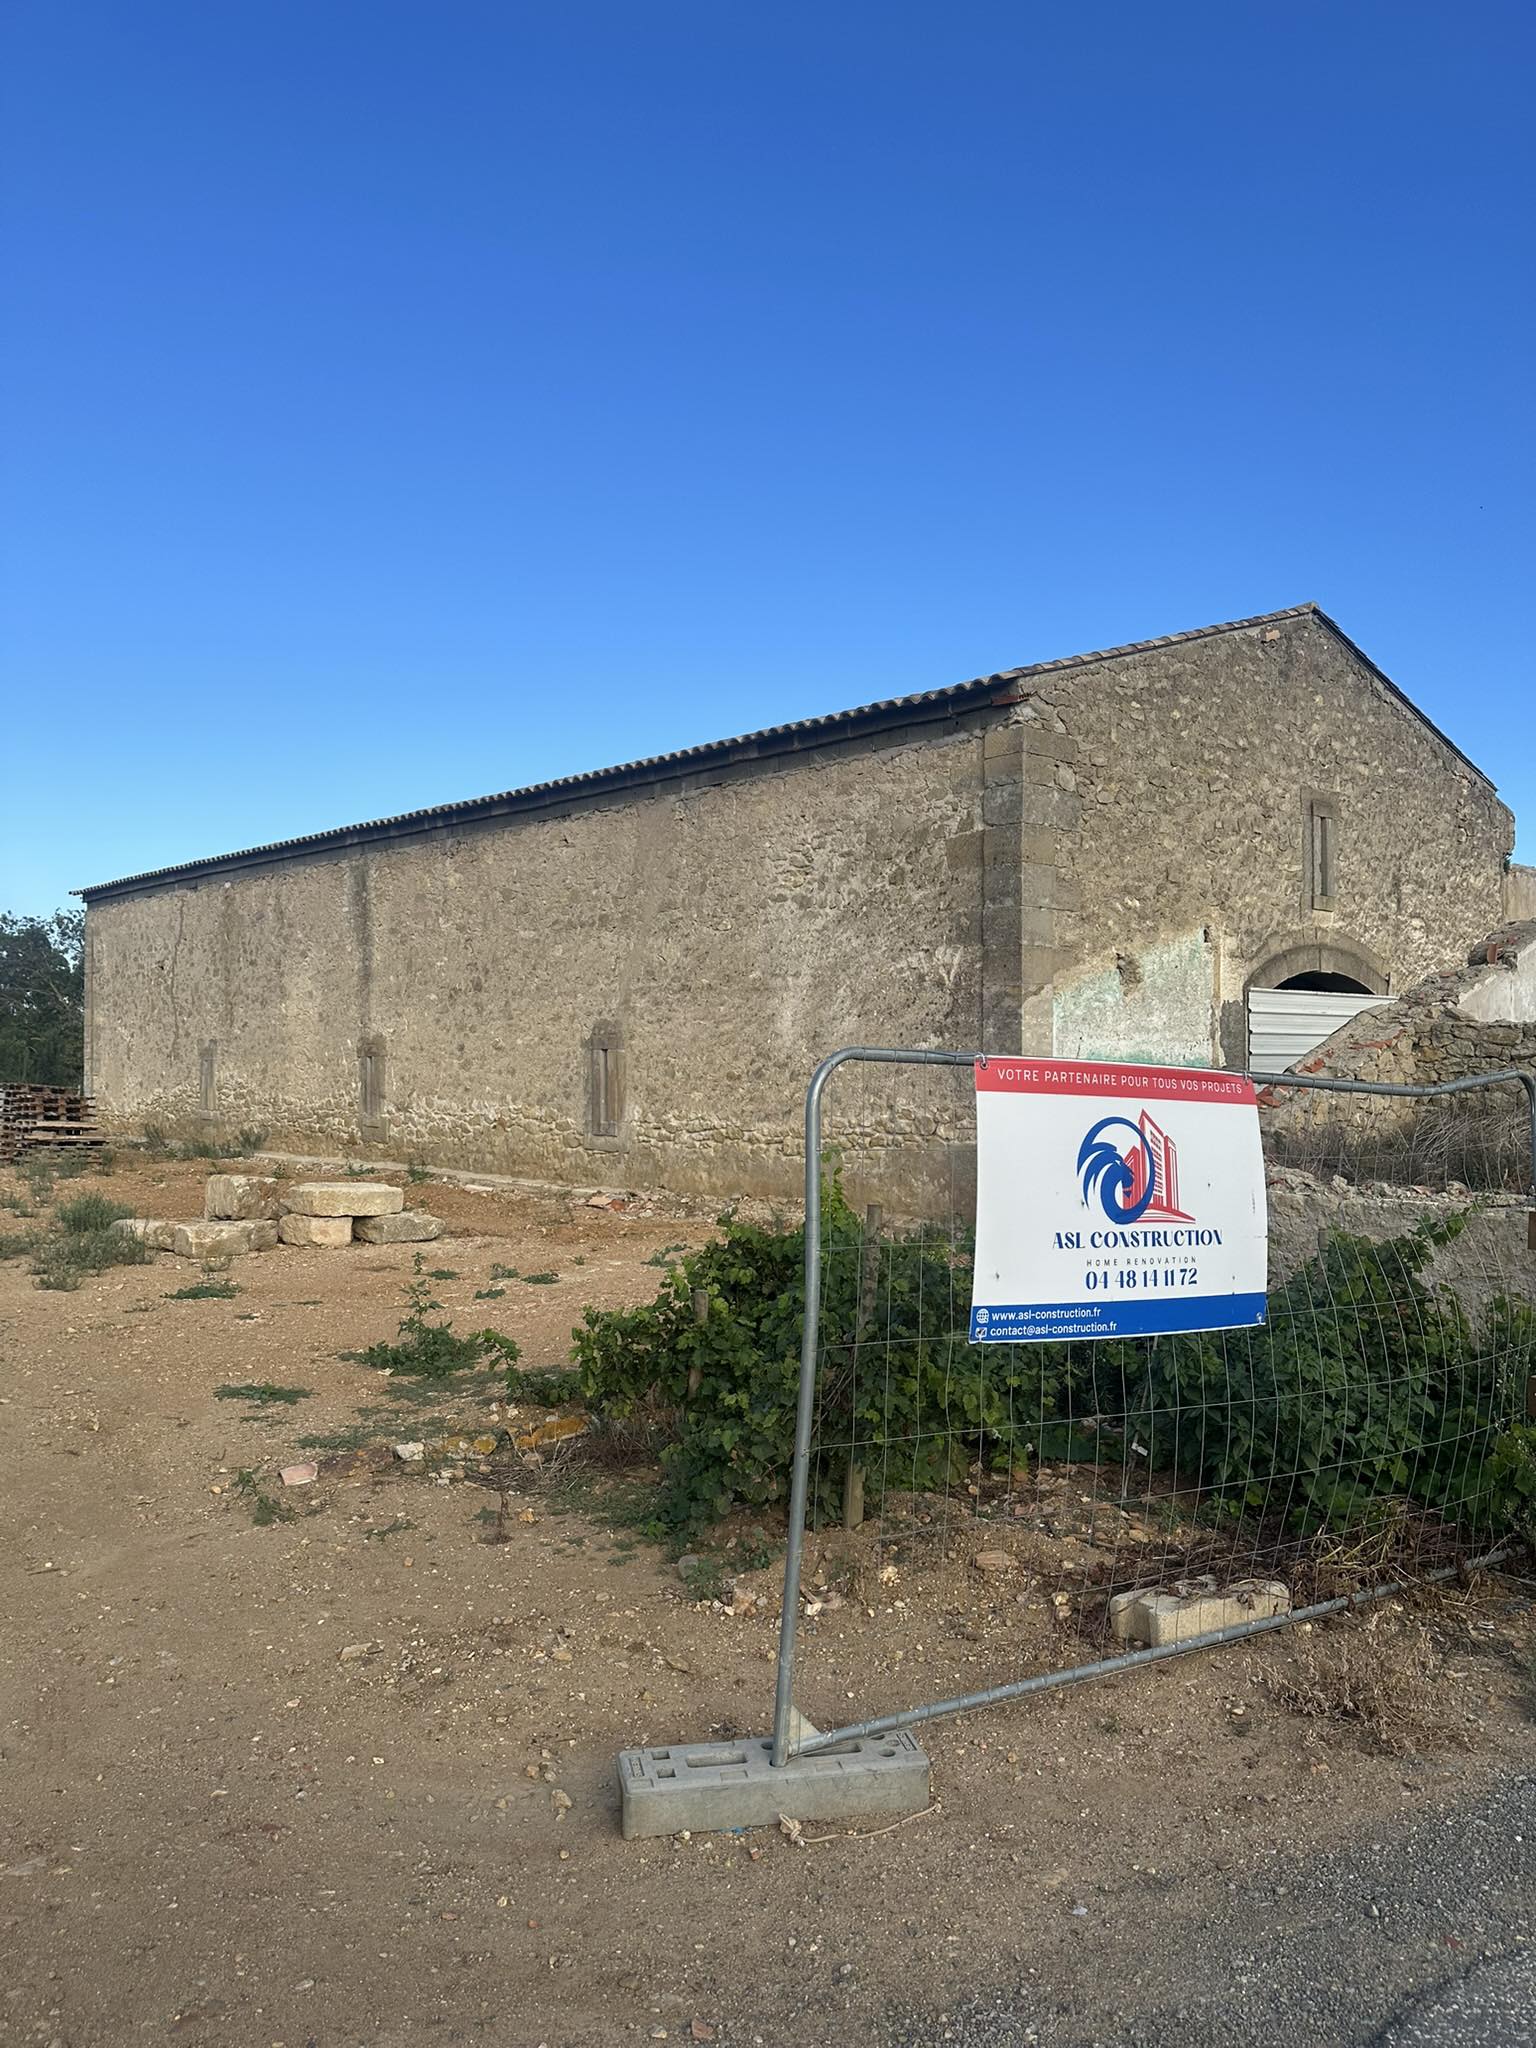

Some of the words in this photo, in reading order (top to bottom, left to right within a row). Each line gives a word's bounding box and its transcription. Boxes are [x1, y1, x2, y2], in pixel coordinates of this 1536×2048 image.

[997, 1068, 1039, 1082] VOTRE
[1044, 1070, 1117, 1086] PARTENAIRE
[1121, 1074, 1149, 1089] POUR
[1152, 1076, 1178, 1090] TOUS
[1180, 1079, 1200, 1092] VOS
[1202, 1080, 1243, 1095] PROJETS
[1053, 1232, 1085, 1249] ASL
[1090, 1229, 1223, 1247] CONSTRUCTION
[1087, 1258, 1118, 1267] HOME
[1127, 1256, 1197, 1266] RENOVATION
[1085, 1271, 1108, 1290] 04
[1115, 1270, 1137, 1289] 48
[1143, 1269, 1158, 1288] 14
[1164, 1268, 1175, 1287] 11
[1180, 1267, 1198, 1286] 72
[991, 1306, 1102, 1321] www.asl-construction.fr
[990, 1321, 1117, 1336] contact@asl-construction.fr
